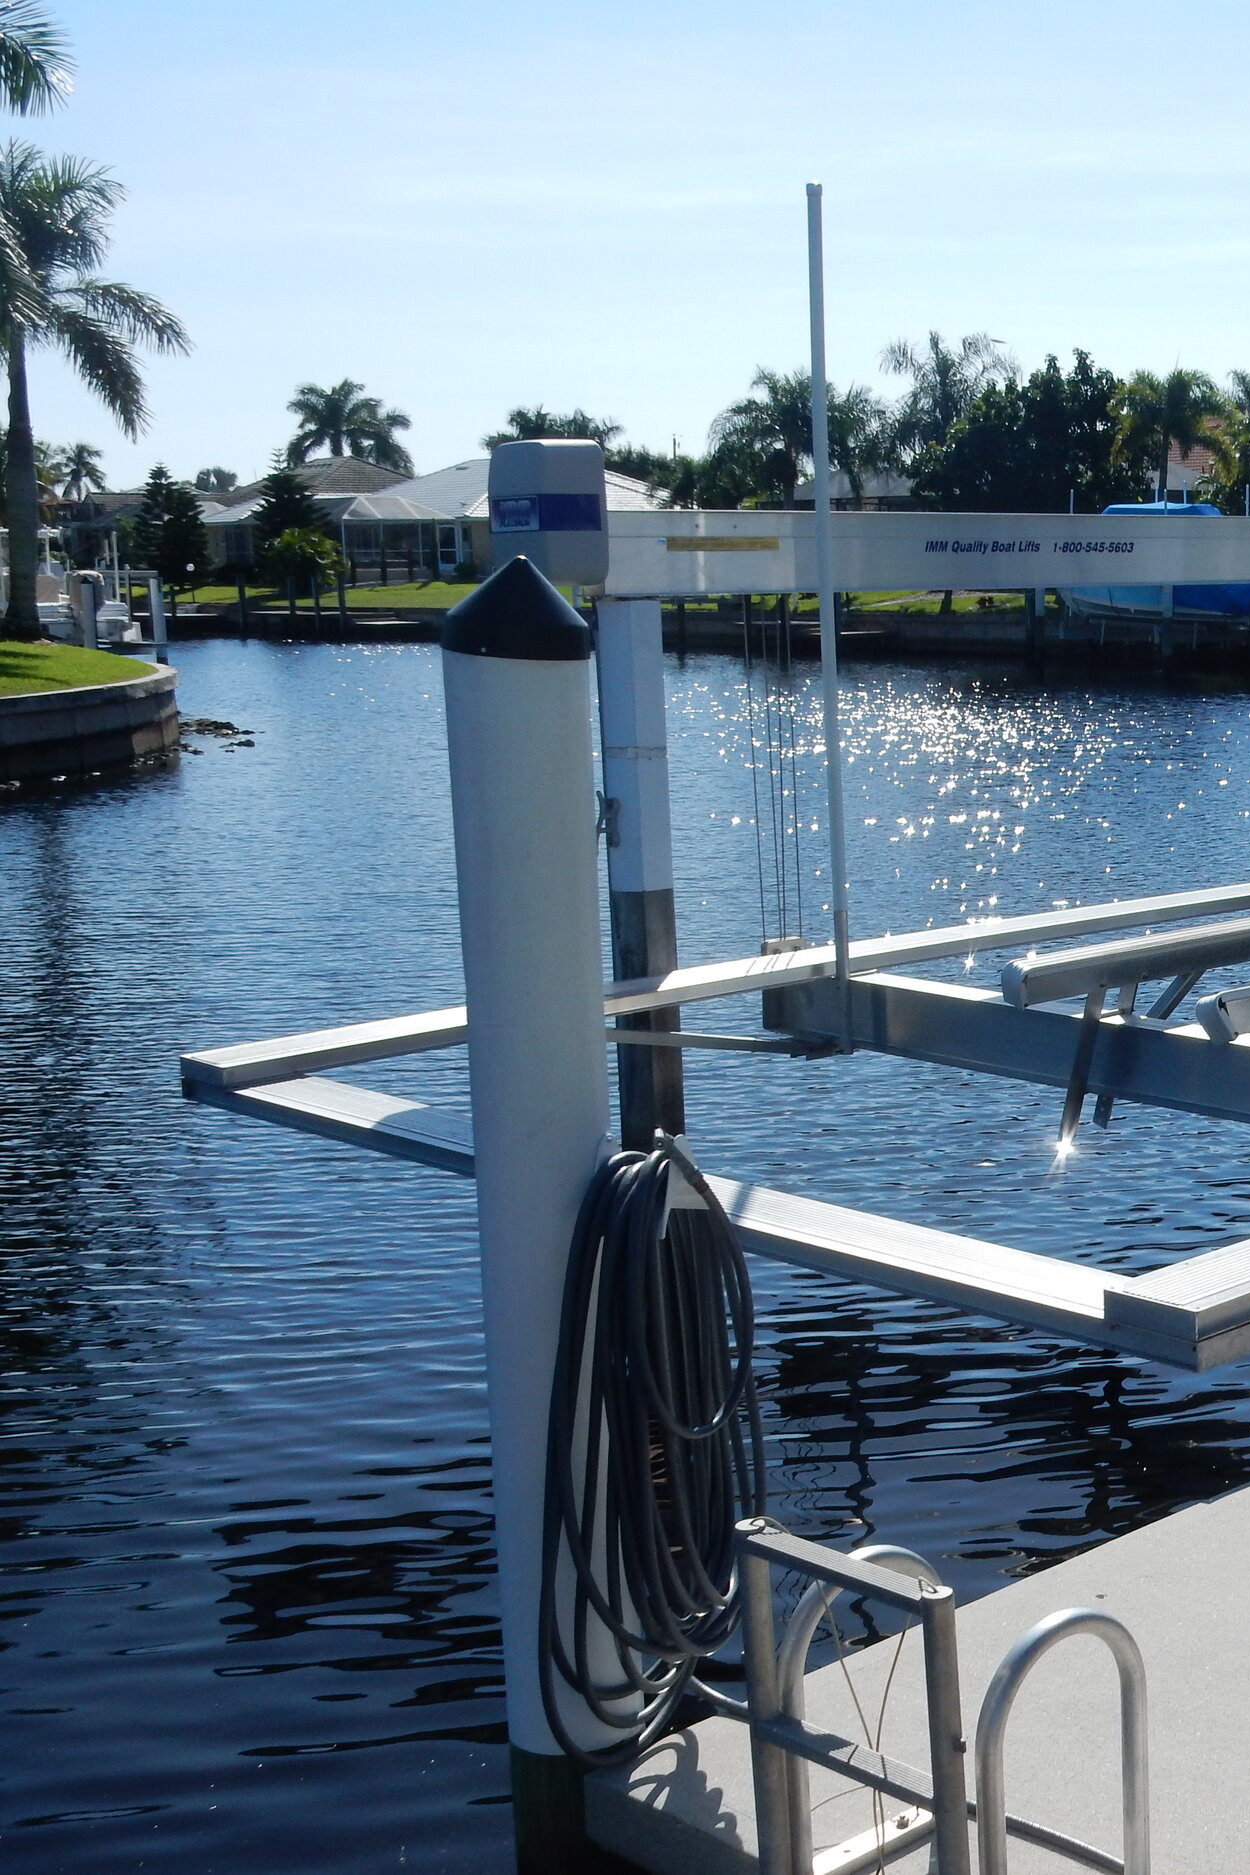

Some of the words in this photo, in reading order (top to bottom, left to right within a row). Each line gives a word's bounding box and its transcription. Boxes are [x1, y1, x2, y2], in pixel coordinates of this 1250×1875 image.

[924, 541, 949, 553] IMM
[951, 541, 988, 555] Quality
[990, 541, 1016, 553] Boat
[1018, 541, 1041, 552] Lifts
[1053, 541, 1135, 553] 1-800-545-5603
